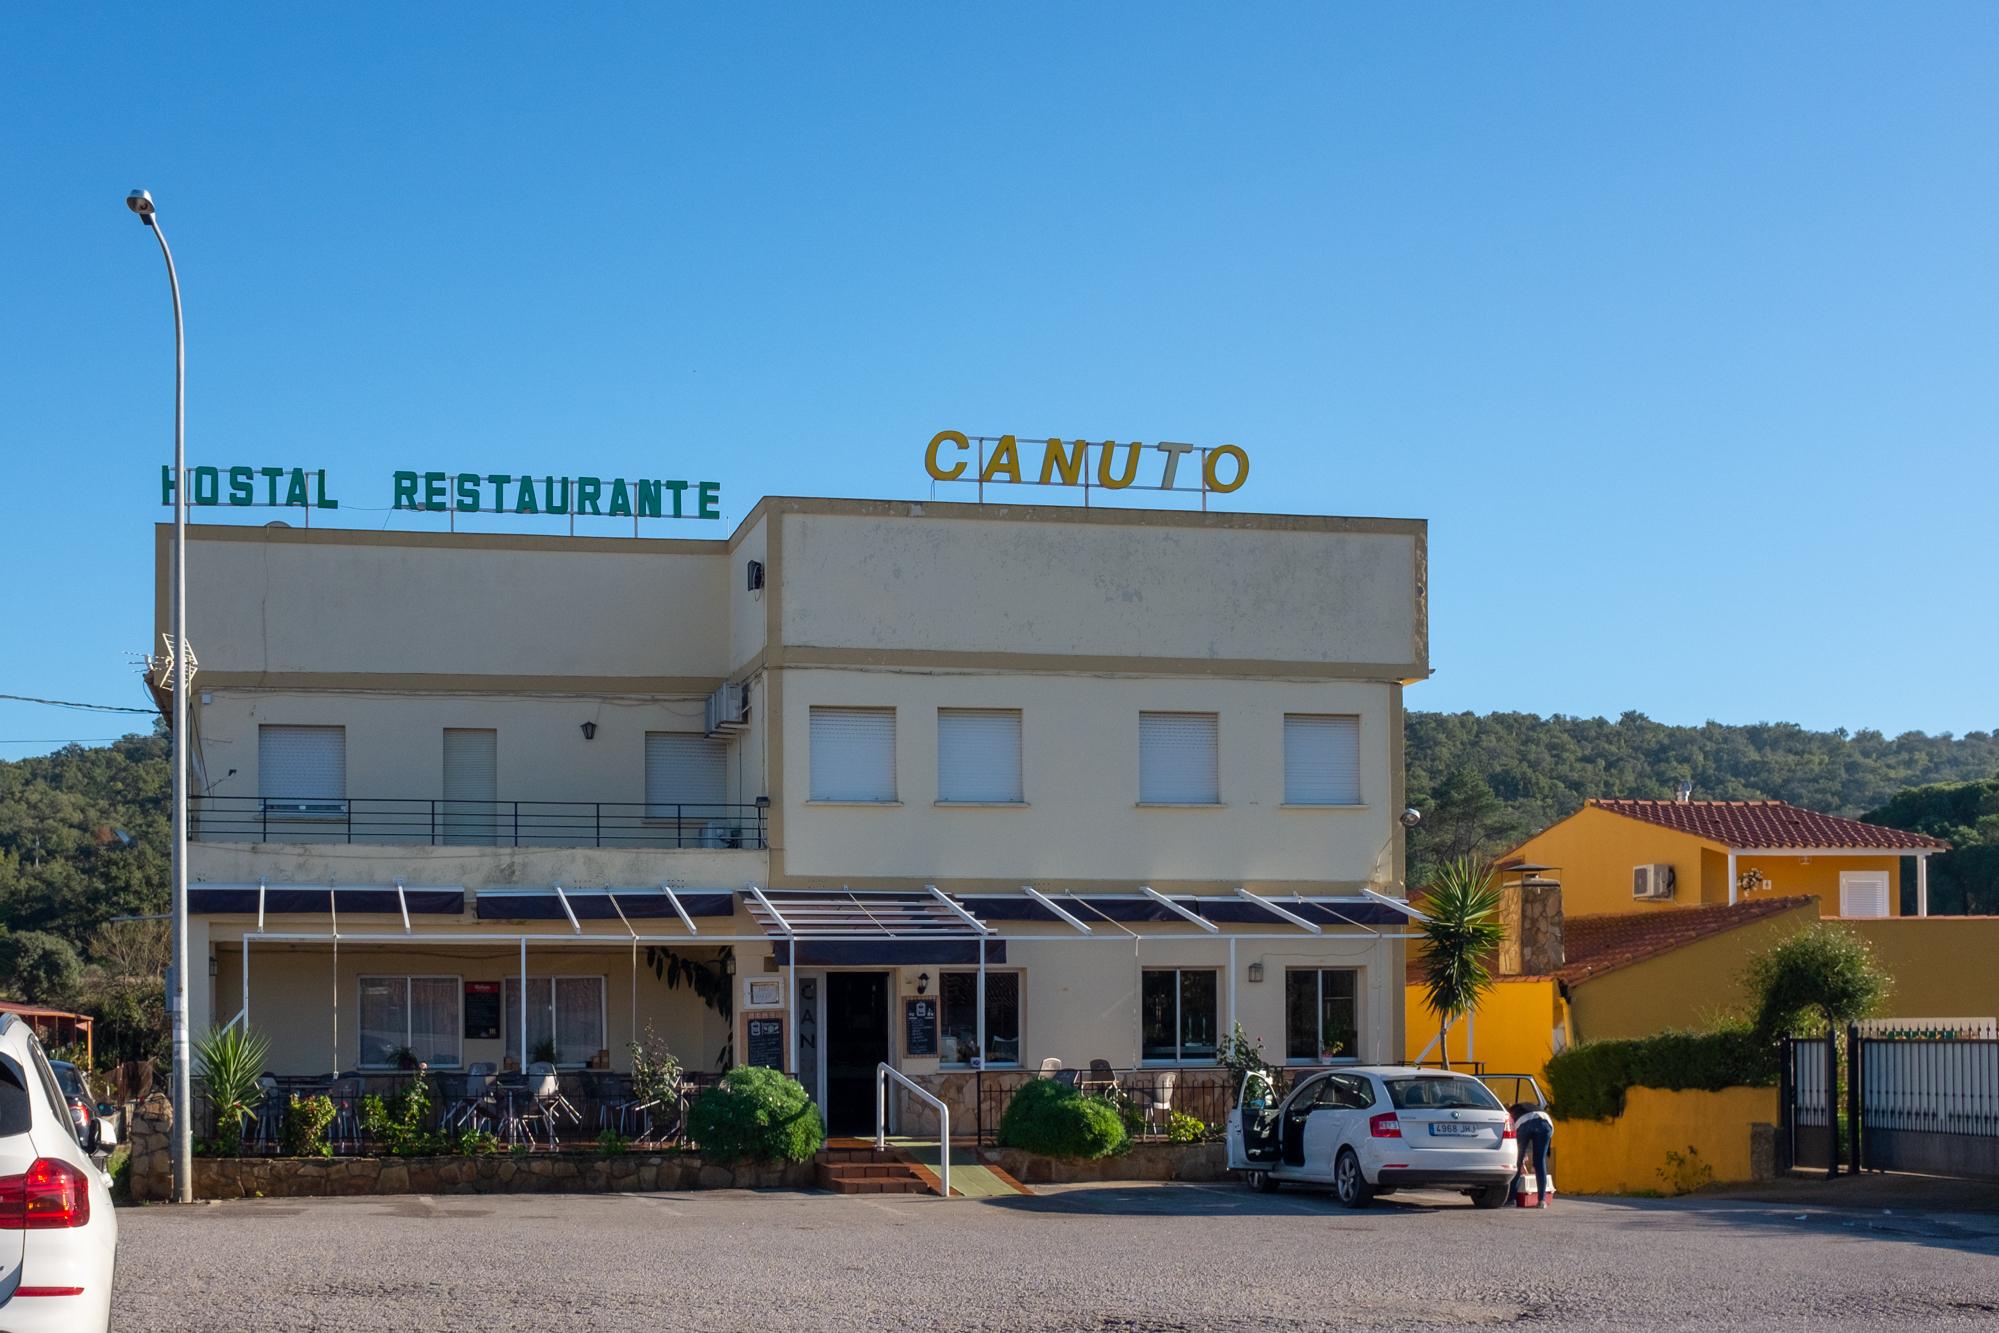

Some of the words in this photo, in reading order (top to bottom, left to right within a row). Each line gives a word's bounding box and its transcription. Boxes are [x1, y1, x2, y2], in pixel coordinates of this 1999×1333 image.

[924, 430, 1250, 493] CANUTO
[162, 465, 338, 509] HOSTAL
[394, 471, 720, 519] RESTAURANTE
[1436, 1124, 1458, 1133] 4968
